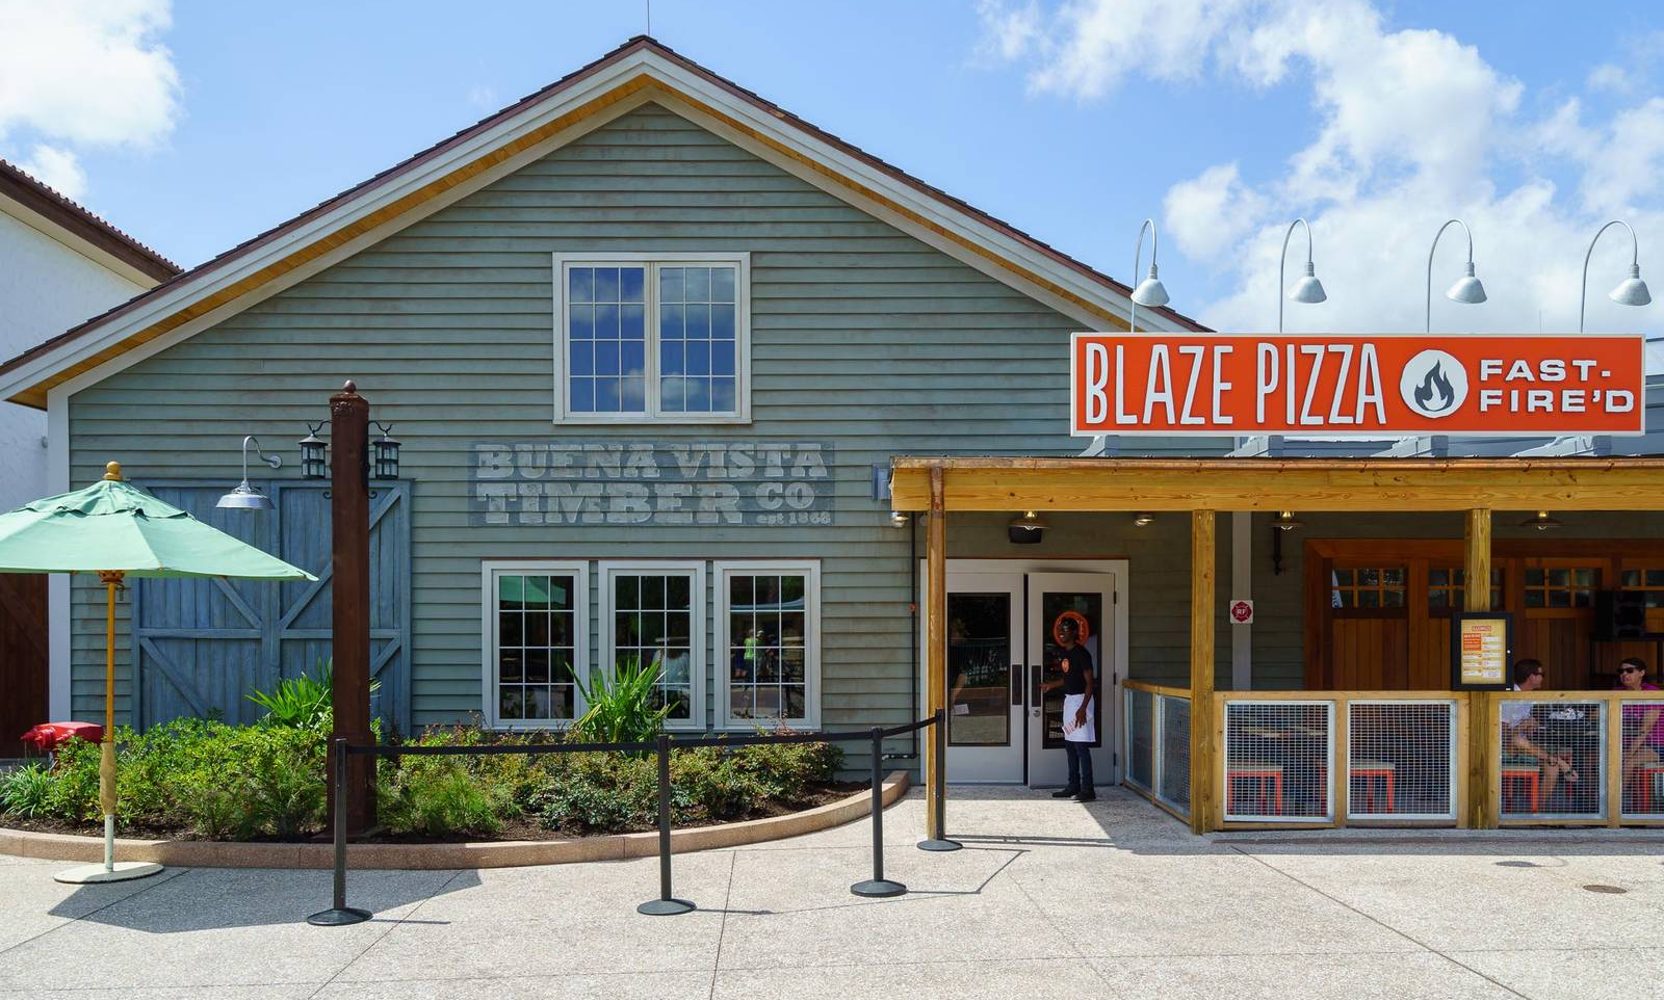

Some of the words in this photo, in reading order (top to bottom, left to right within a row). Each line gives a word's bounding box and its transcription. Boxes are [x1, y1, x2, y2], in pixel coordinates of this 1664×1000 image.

[1085, 342, 1233, 424] BLAZE
[1257, 342, 1386, 424] PIZZA
[1480, 359, 1611, 382] FAST-
[1480, 389, 1634, 412] FIRE'D
[475, 443, 660, 479] BUENA
[673, 443, 829, 478] VISTA
[476, 482, 743, 524] TIMBER
[755, 482, 815, 510] CO
